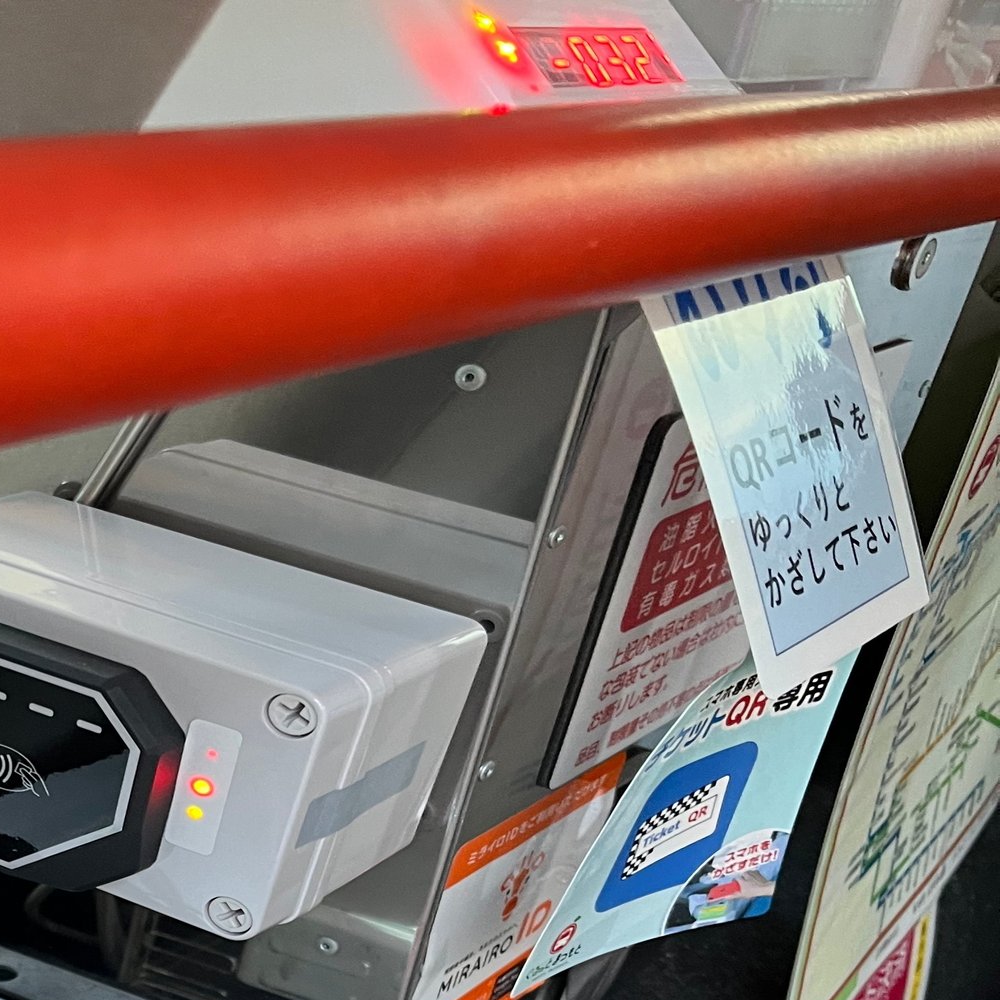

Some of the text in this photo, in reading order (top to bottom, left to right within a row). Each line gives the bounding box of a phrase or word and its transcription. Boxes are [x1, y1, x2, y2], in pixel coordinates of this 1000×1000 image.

[730, 394, 869, 491] QRコードを
[749, 475, 850, 552] ゆっくりと
[765, 515, 897, 609] かざして下さい
[642, 805, 709, 848] Ticket QR
[724, 840, 771, 863] スマホを
[436, 934, 514, 999] MIRAIRO
[515, 899, 552, 944] ID
